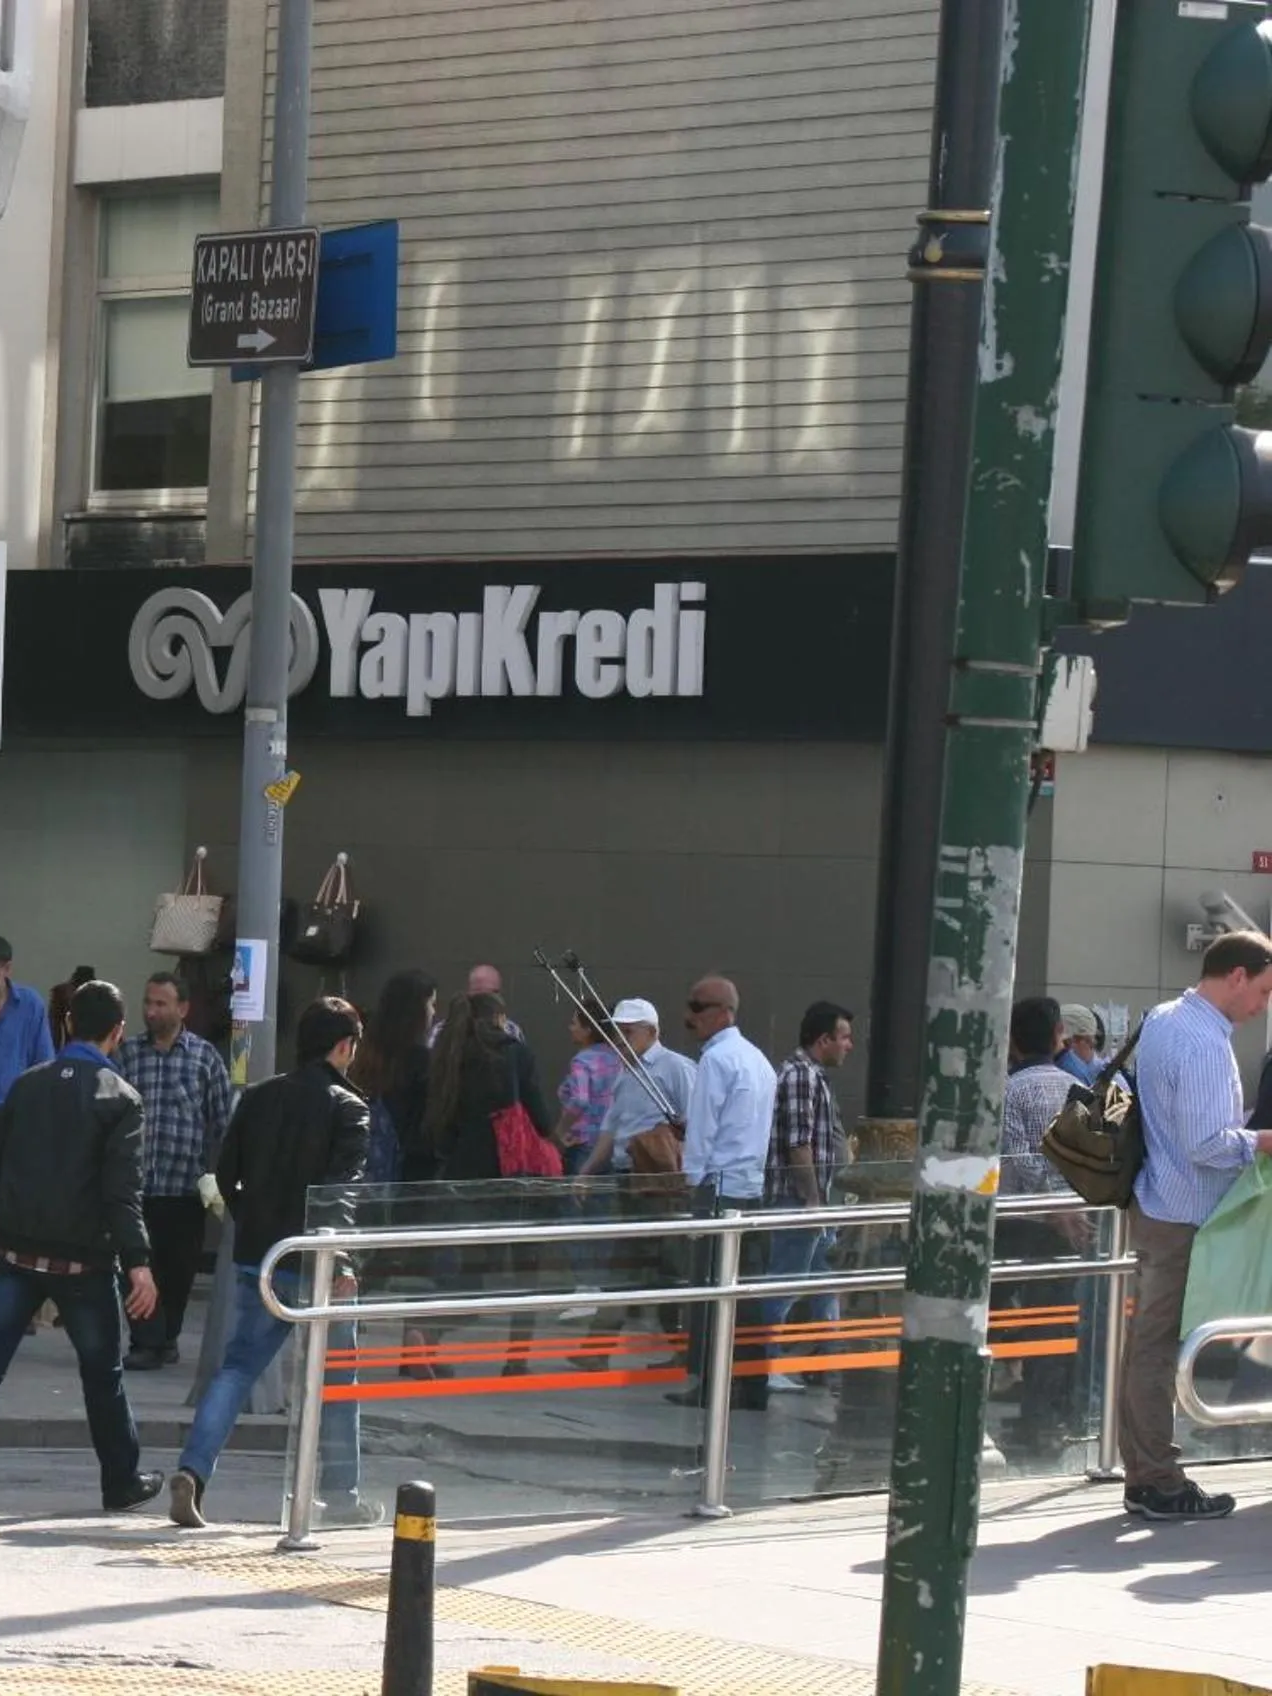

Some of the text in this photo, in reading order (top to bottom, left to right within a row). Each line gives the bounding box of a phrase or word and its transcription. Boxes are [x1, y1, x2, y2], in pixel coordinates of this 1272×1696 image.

[197, 239, 315, 287] KAPALI ÇARŞI
[201, 288, 301, 325] (Grand Bazaar)
[318, 581, 707, 716] YapıKredi
